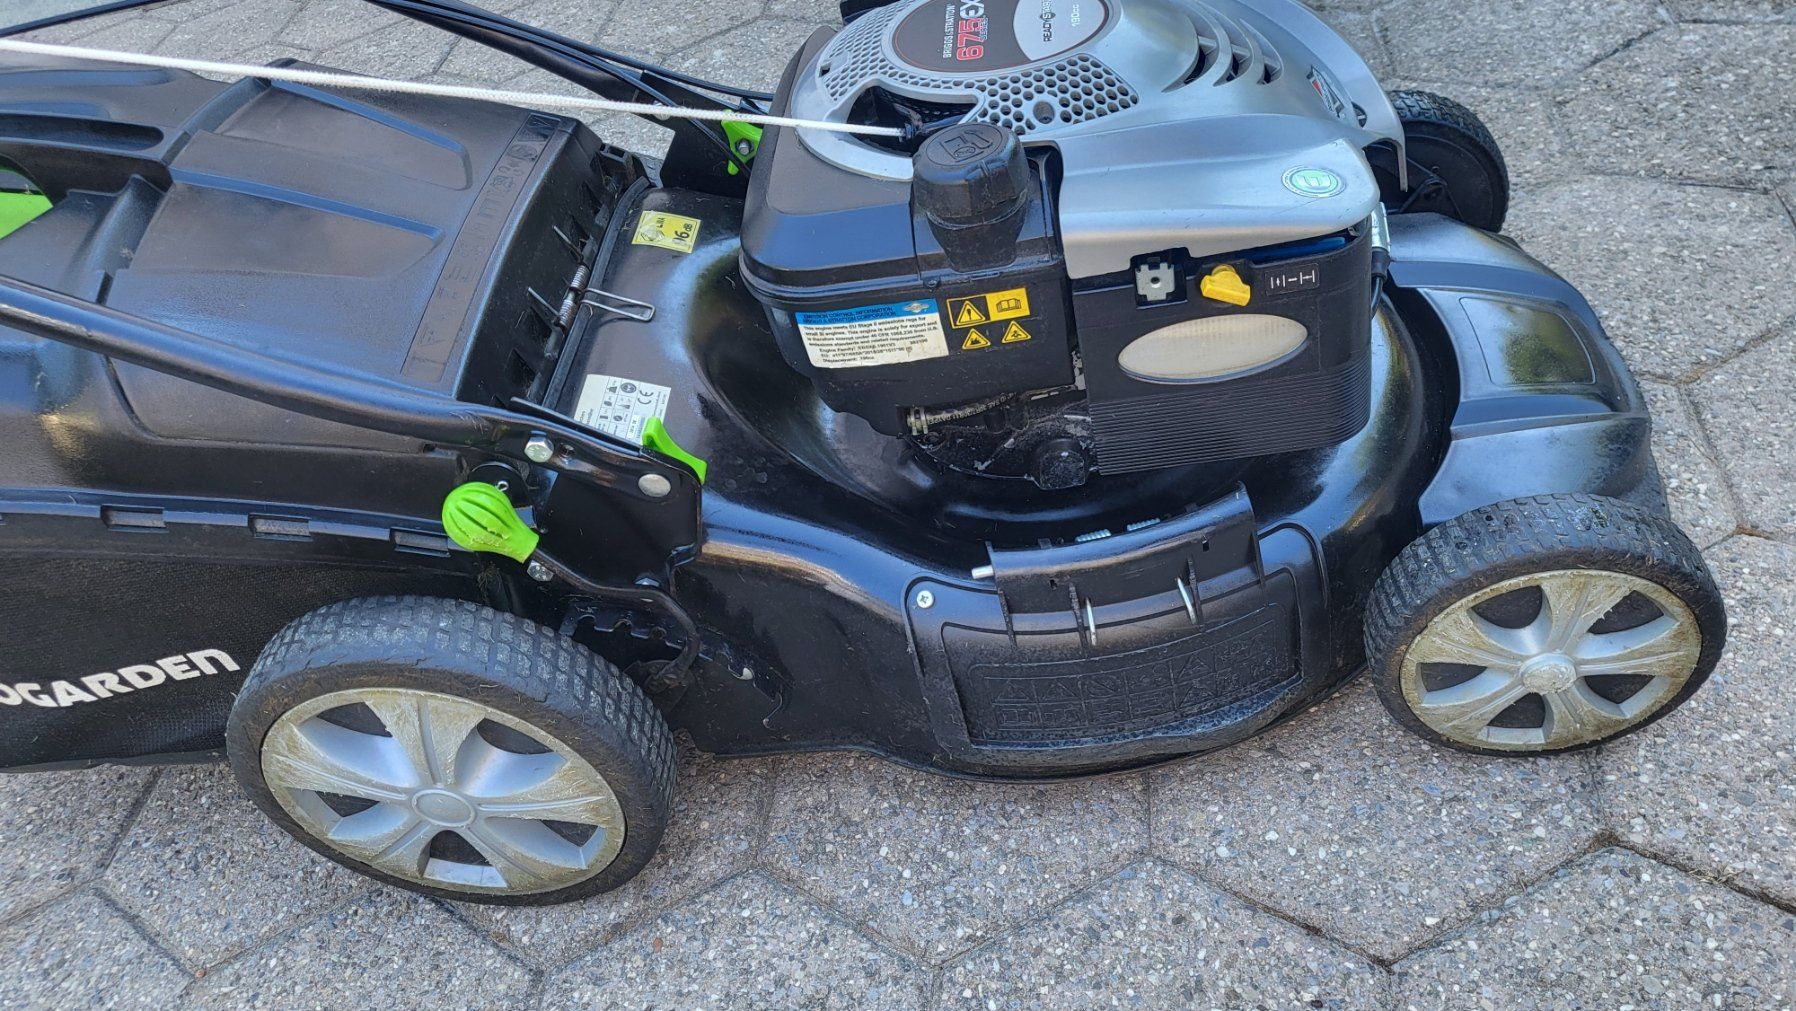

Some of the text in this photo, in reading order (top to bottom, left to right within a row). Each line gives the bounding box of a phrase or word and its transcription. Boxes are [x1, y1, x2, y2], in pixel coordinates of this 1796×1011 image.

[944, 4, 956, 32] STRATTON
[1070, 4, 1080, 26] 190cc
[942, 36, 954, 58] BRIGGS
[683, 222, 692, 232] dB
